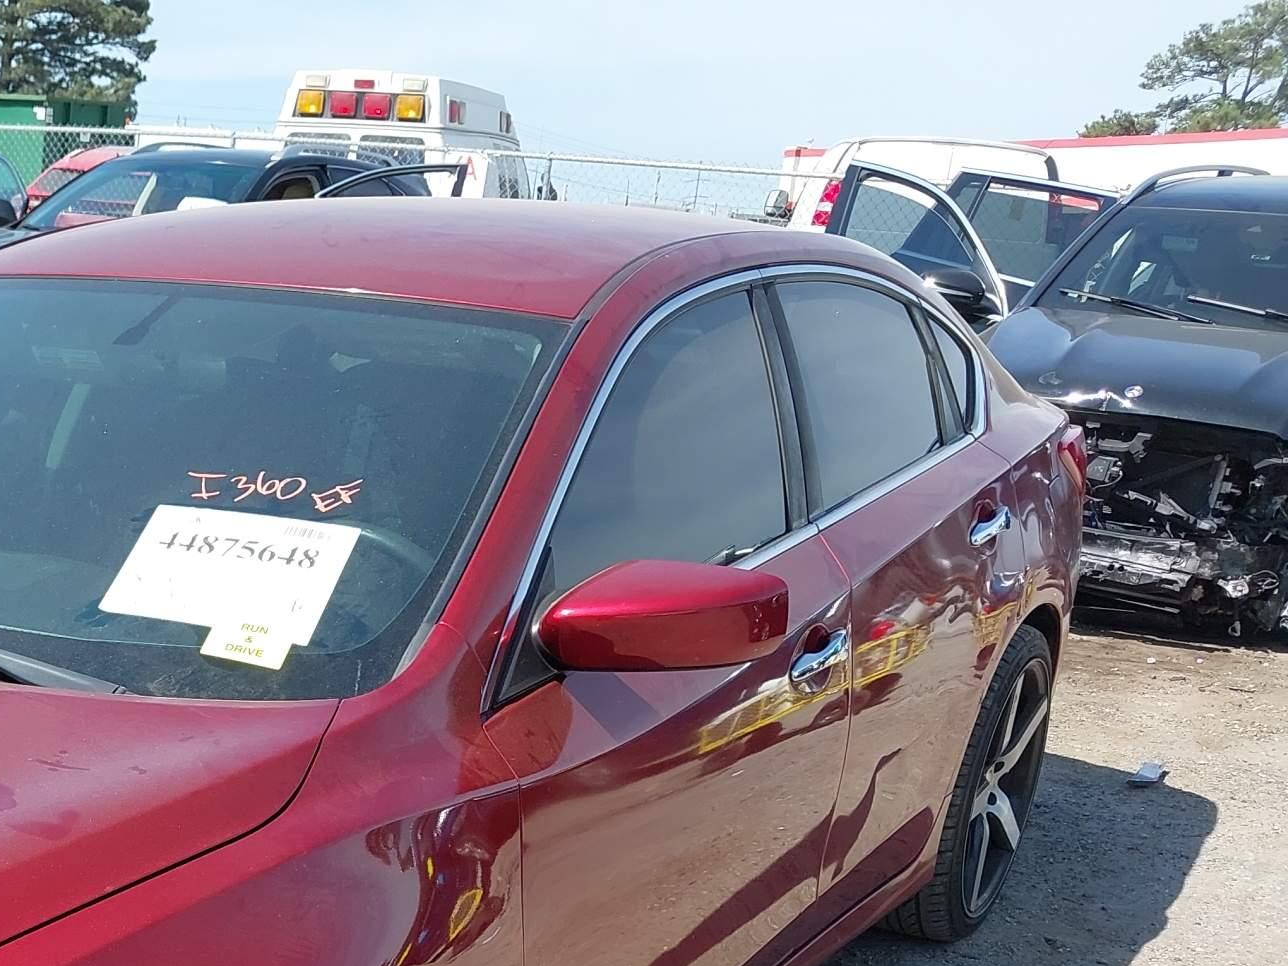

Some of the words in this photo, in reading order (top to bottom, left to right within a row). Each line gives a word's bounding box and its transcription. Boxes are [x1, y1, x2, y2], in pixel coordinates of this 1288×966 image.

[159, 531, 320, 569] 44875648
[240, 623, 269, 635] RUN
[224, 643, 265, 658] DRIVE
